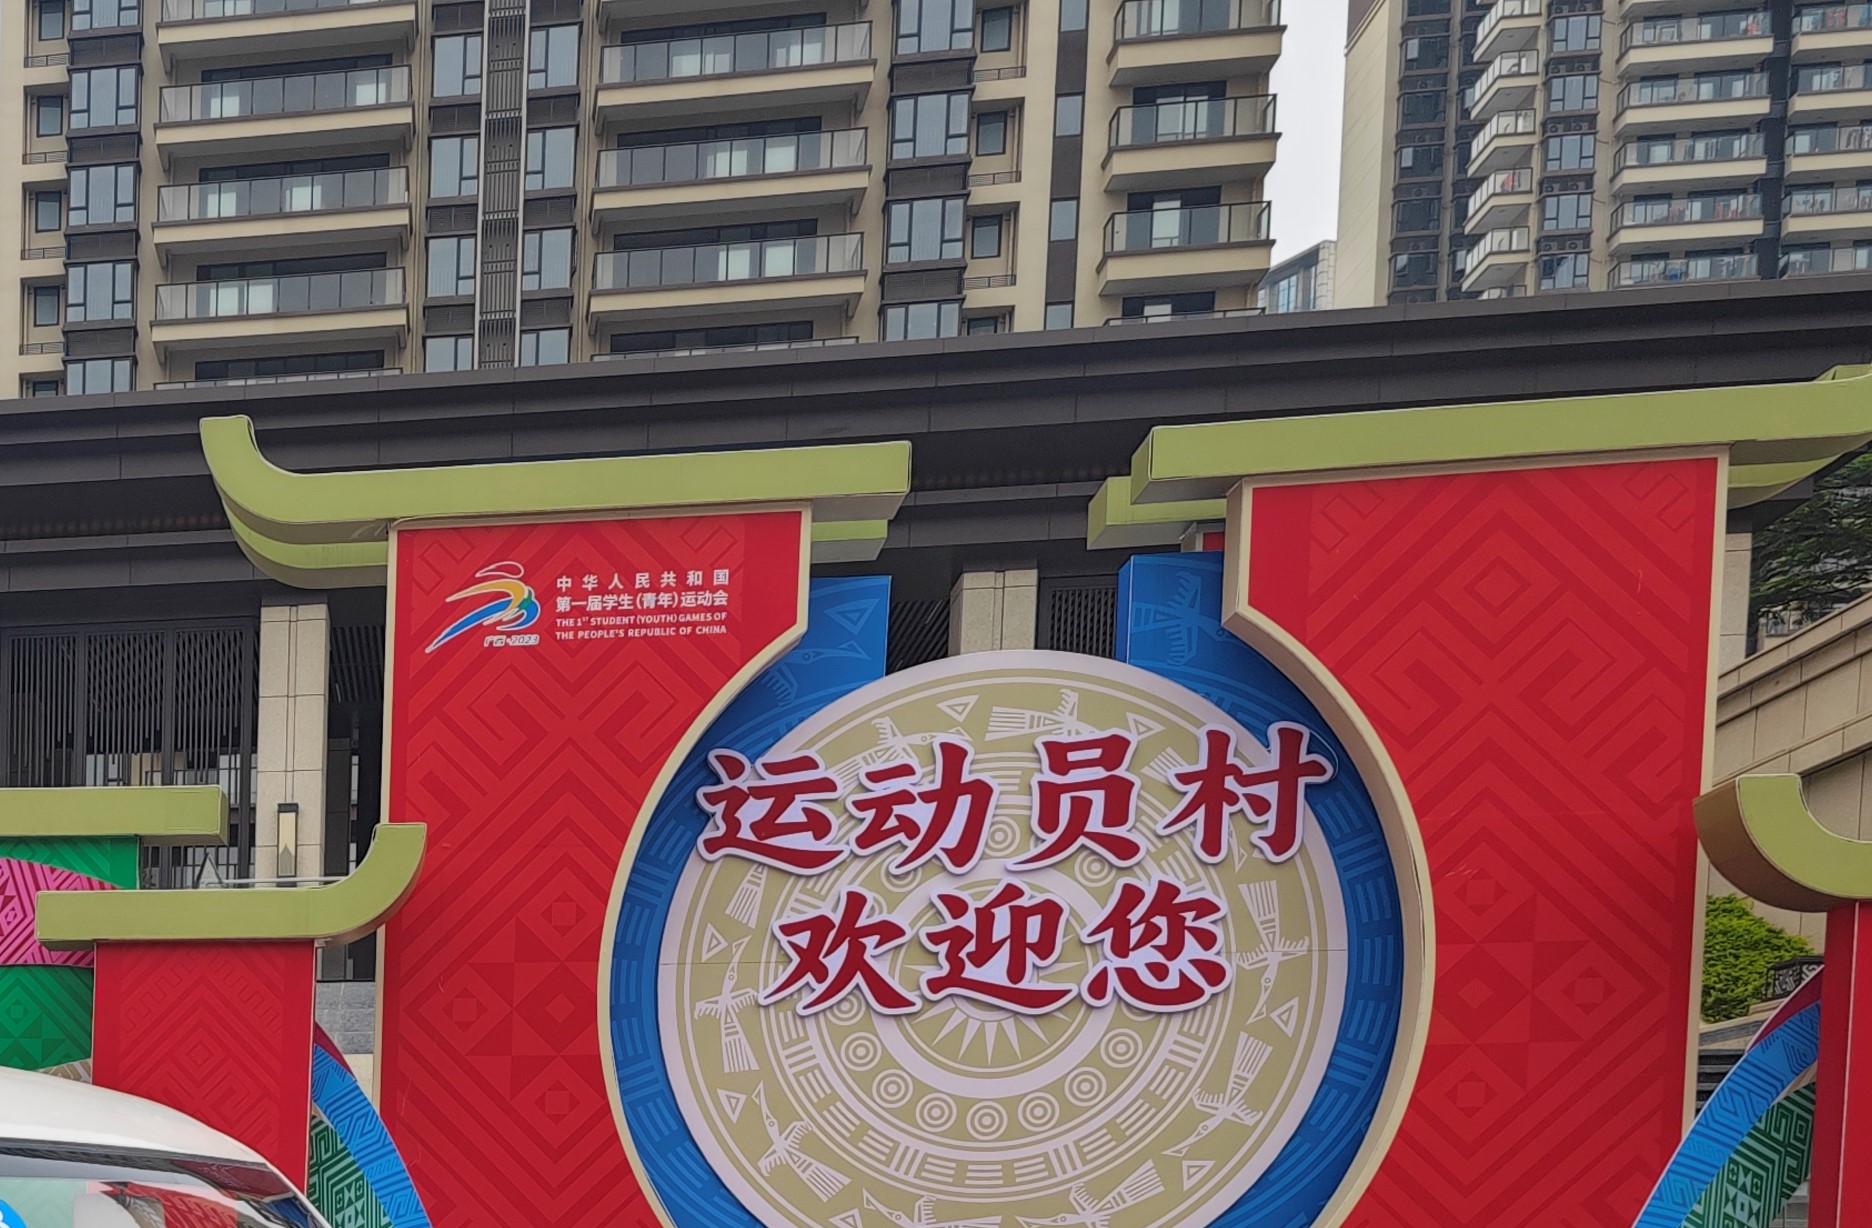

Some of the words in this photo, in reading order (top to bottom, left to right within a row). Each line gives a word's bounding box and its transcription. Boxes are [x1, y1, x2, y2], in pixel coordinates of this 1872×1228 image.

[556, 569, 729, 592] 中华人民共和国
[556, 618, 575, 627] THE
[590, 615, 635, 626] STUDENT
[636, 614, 677, 625] (YOUTH)
[678, 612, 712, 623] GAMES
[714, 612, 727, 621] OF
[556, 631, 575, 640] THE
[577, 629, 624, 639] PEOPLE'S
[628, 627, 676, 637] REPUBLIC
[679, 626, 692, 635] OF
[696, 625, 726, 634] CHINA
[702, 727, 1330, 870] 运动员村
[762, 880, 1227, 1014] 欢迎您
